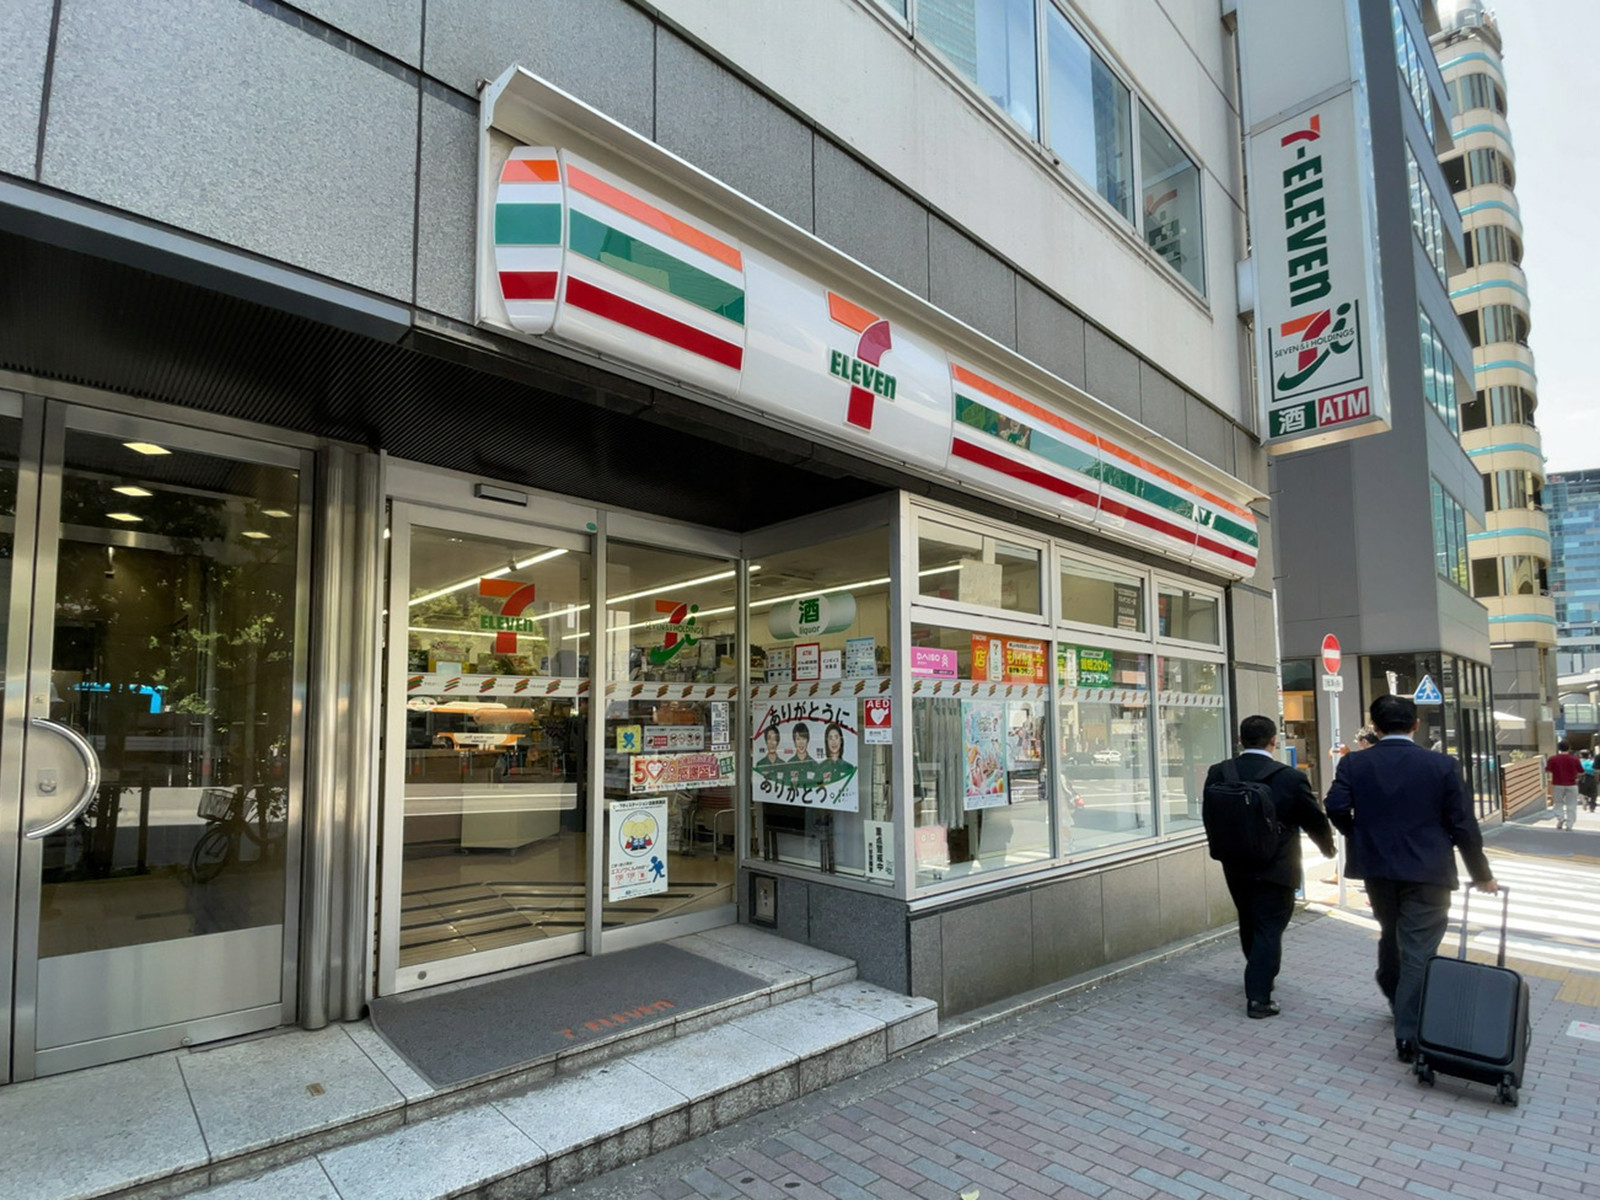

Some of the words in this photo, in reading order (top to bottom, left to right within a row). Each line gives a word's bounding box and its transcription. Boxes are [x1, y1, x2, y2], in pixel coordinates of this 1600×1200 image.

[1311, 327, 1355, 347] HOLDINGS
[1321, 390, 1368, 424] ATM
[1278, 405, 1306, 434] 酒
[798, 597, 820, 625] 酒
[800, 625, 821, 635] liquor
[916, 652, 940, 662] DAISO
[866, 700, 890, 709] AED
